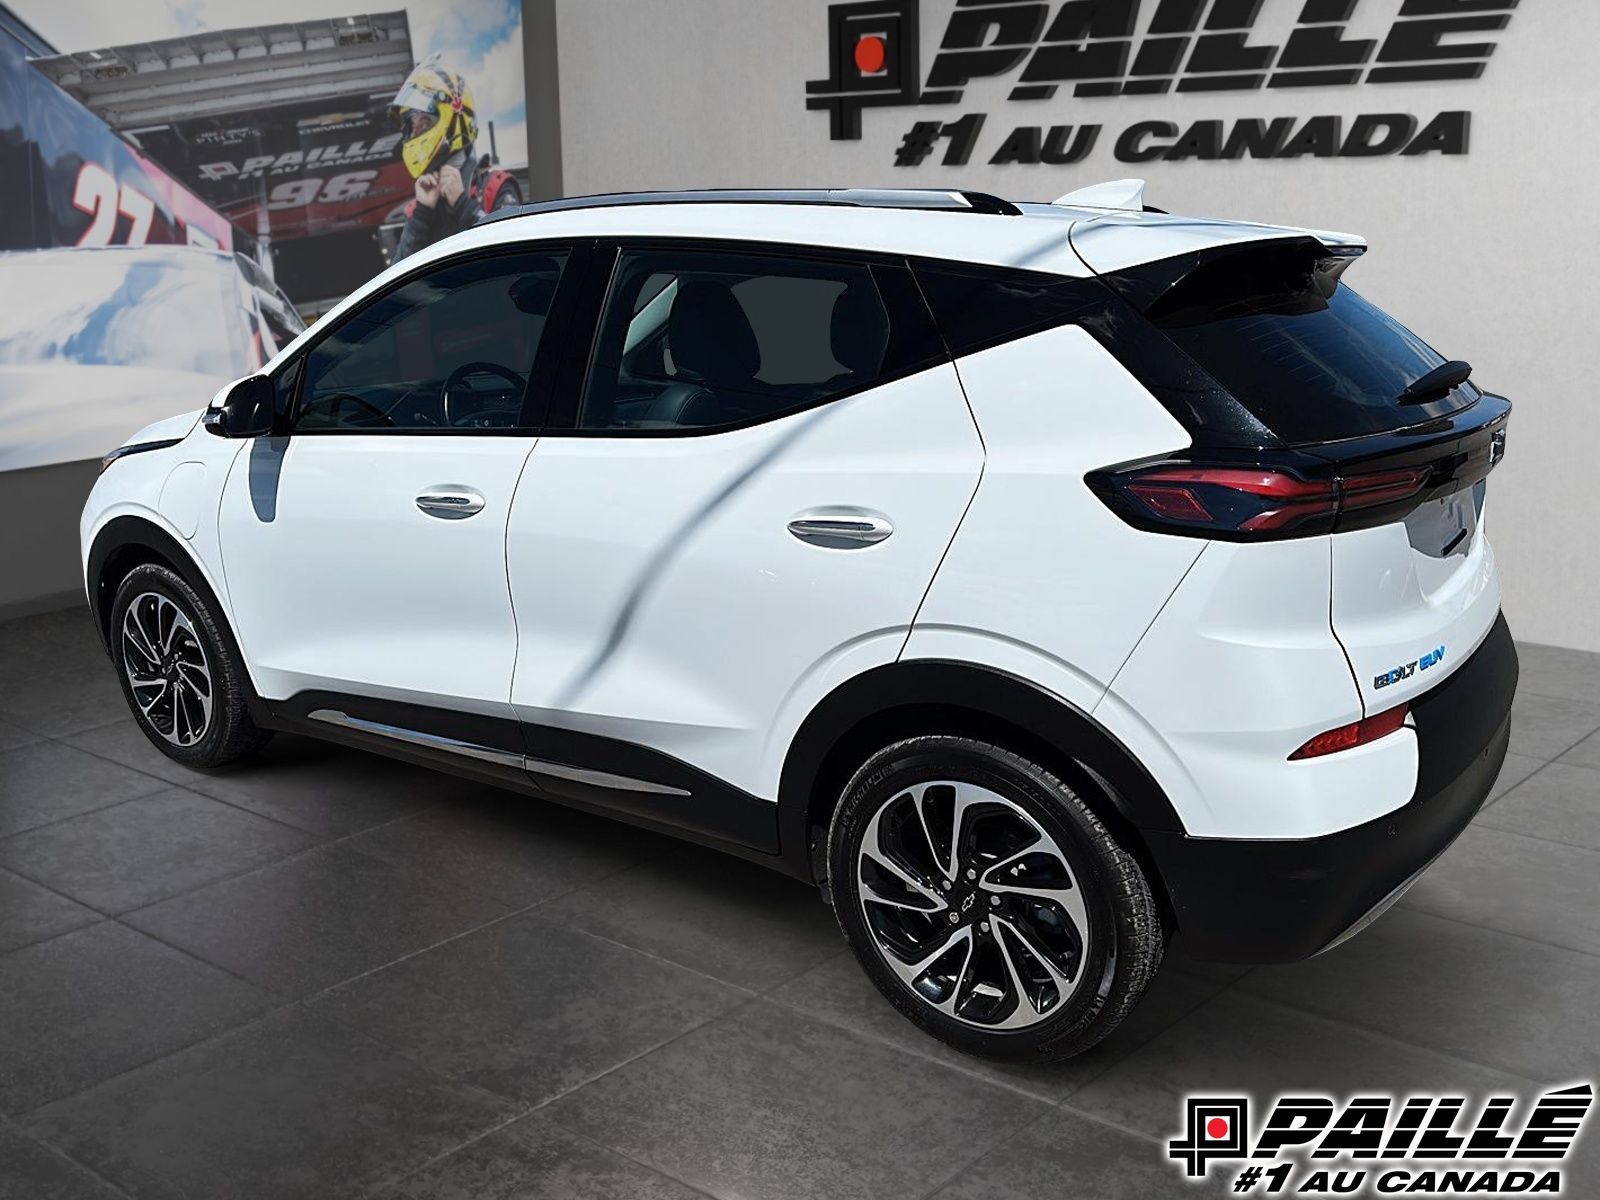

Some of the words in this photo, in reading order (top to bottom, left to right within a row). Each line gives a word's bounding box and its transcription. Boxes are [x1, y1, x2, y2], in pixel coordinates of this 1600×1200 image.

[298, 120, 371, 136] CHEVROLET
[894, 113, 987, 167] #1
[988, 124, 1103, 165] AU
[1113, 110, 1471, 163] CANADA
[270, 164, 300, 176] AU
[306, 151, 393, 169] CANADA
[73, 160, 155, 249] 27
[267, 169, 378, 211] 96
[1374, 660, 1418, 690] BOLT
[1419, 645, 1446, 671] EUV
